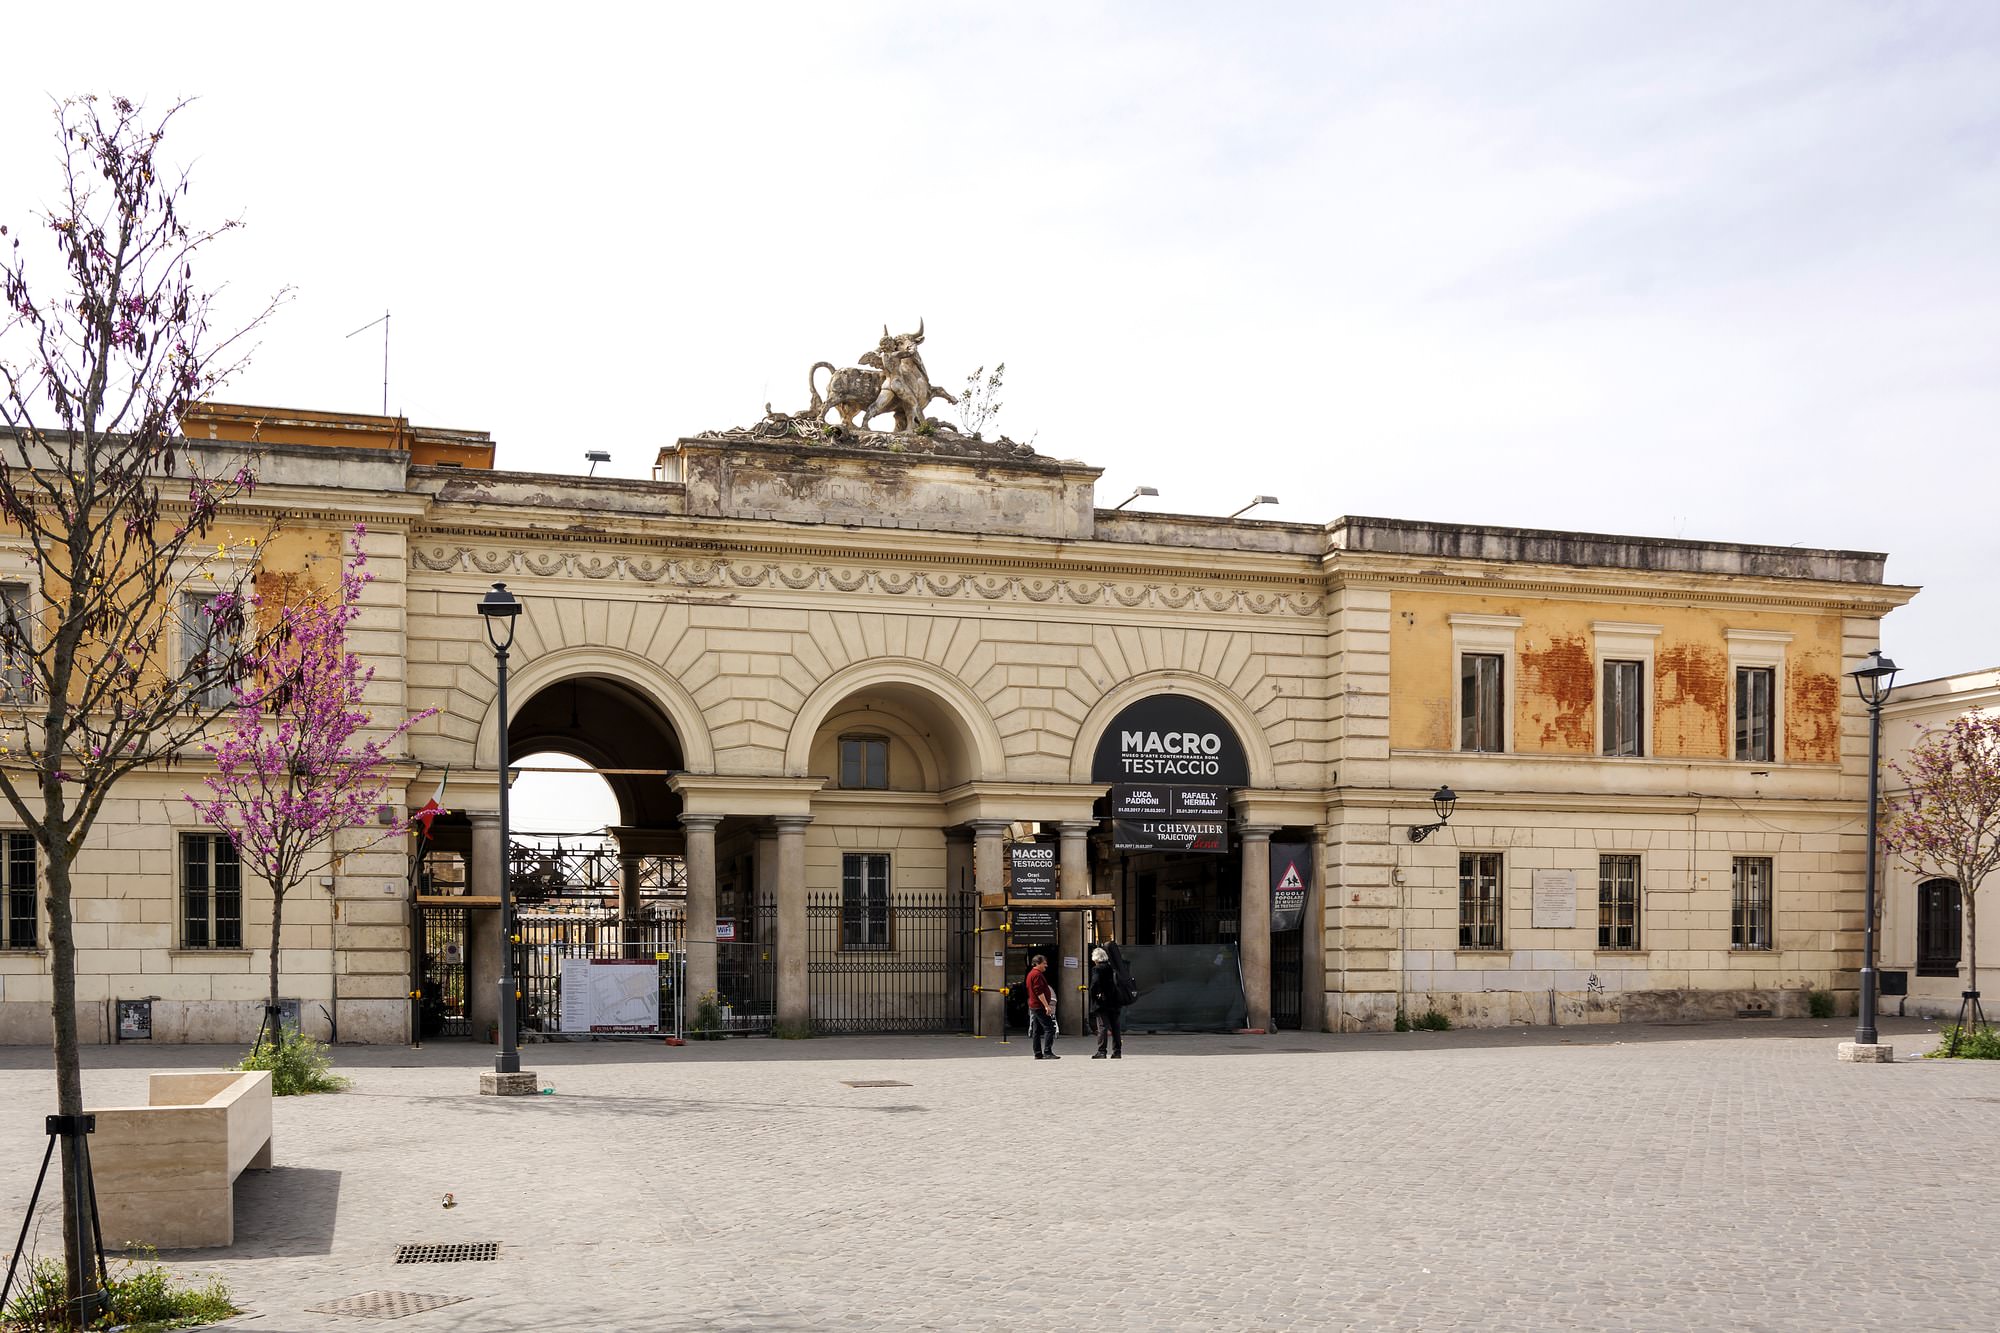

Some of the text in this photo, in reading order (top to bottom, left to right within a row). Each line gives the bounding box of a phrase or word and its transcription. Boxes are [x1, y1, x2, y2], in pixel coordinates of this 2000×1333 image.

[1122, 731, 1221, 754] MACRO
[1122, 759, 1219, 775] TESTACCIO
[1143, 823, 1223, 834] LI CHEVALIER
[1157, 833, 1197, 841] TRAJECTORY
[1185, 841, 1193, 849] of
[1012, 849, 1053, 859] MACRO
[1012, 860, 1053, 868] TESTACCIO
